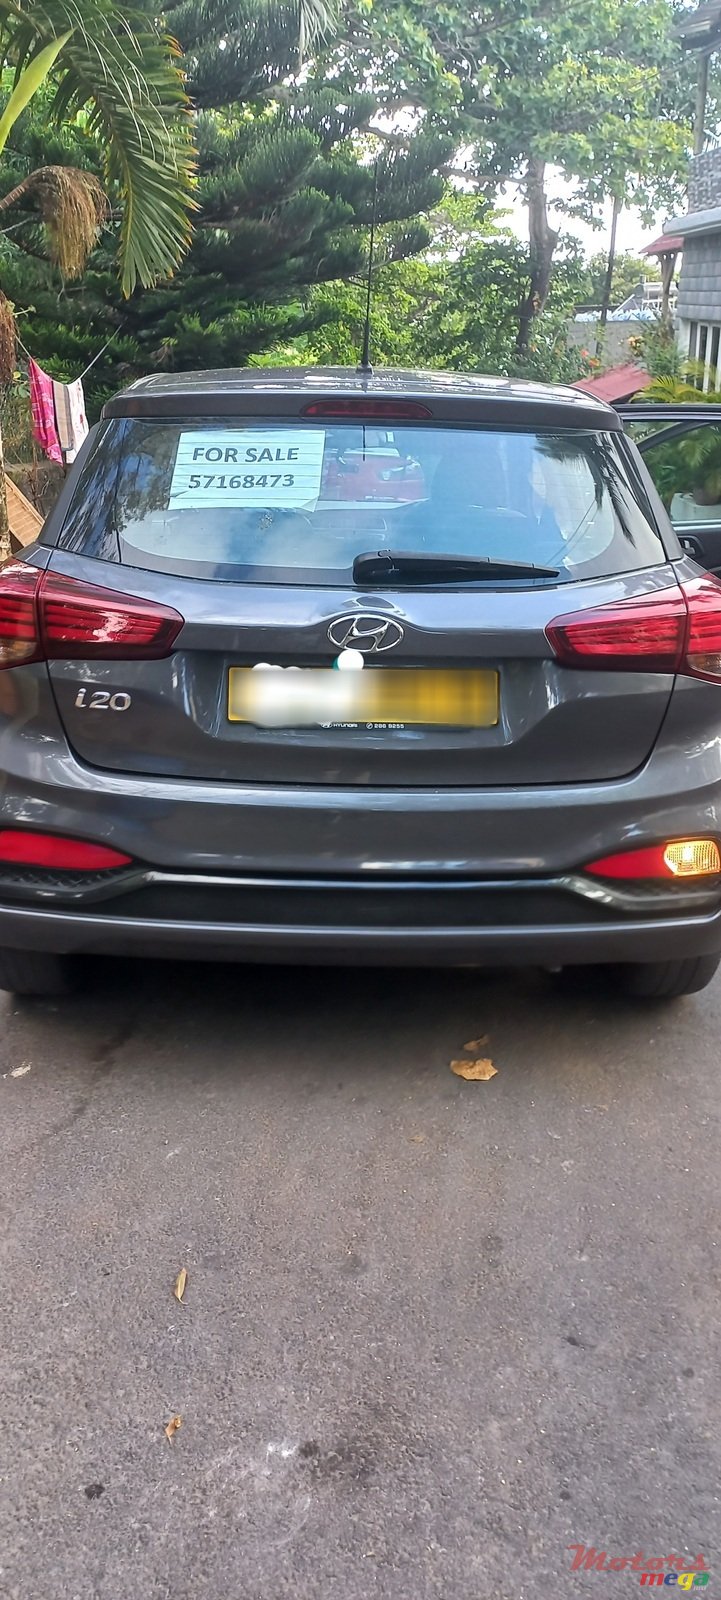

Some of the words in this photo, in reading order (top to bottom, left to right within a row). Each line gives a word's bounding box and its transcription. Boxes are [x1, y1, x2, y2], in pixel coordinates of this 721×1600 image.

[192, 447, 238, 463] FOR
[245, 447, 300, 463] SALE
[188, 474, 295, 489] 57168473
[75, 688, 132, 711] i20
